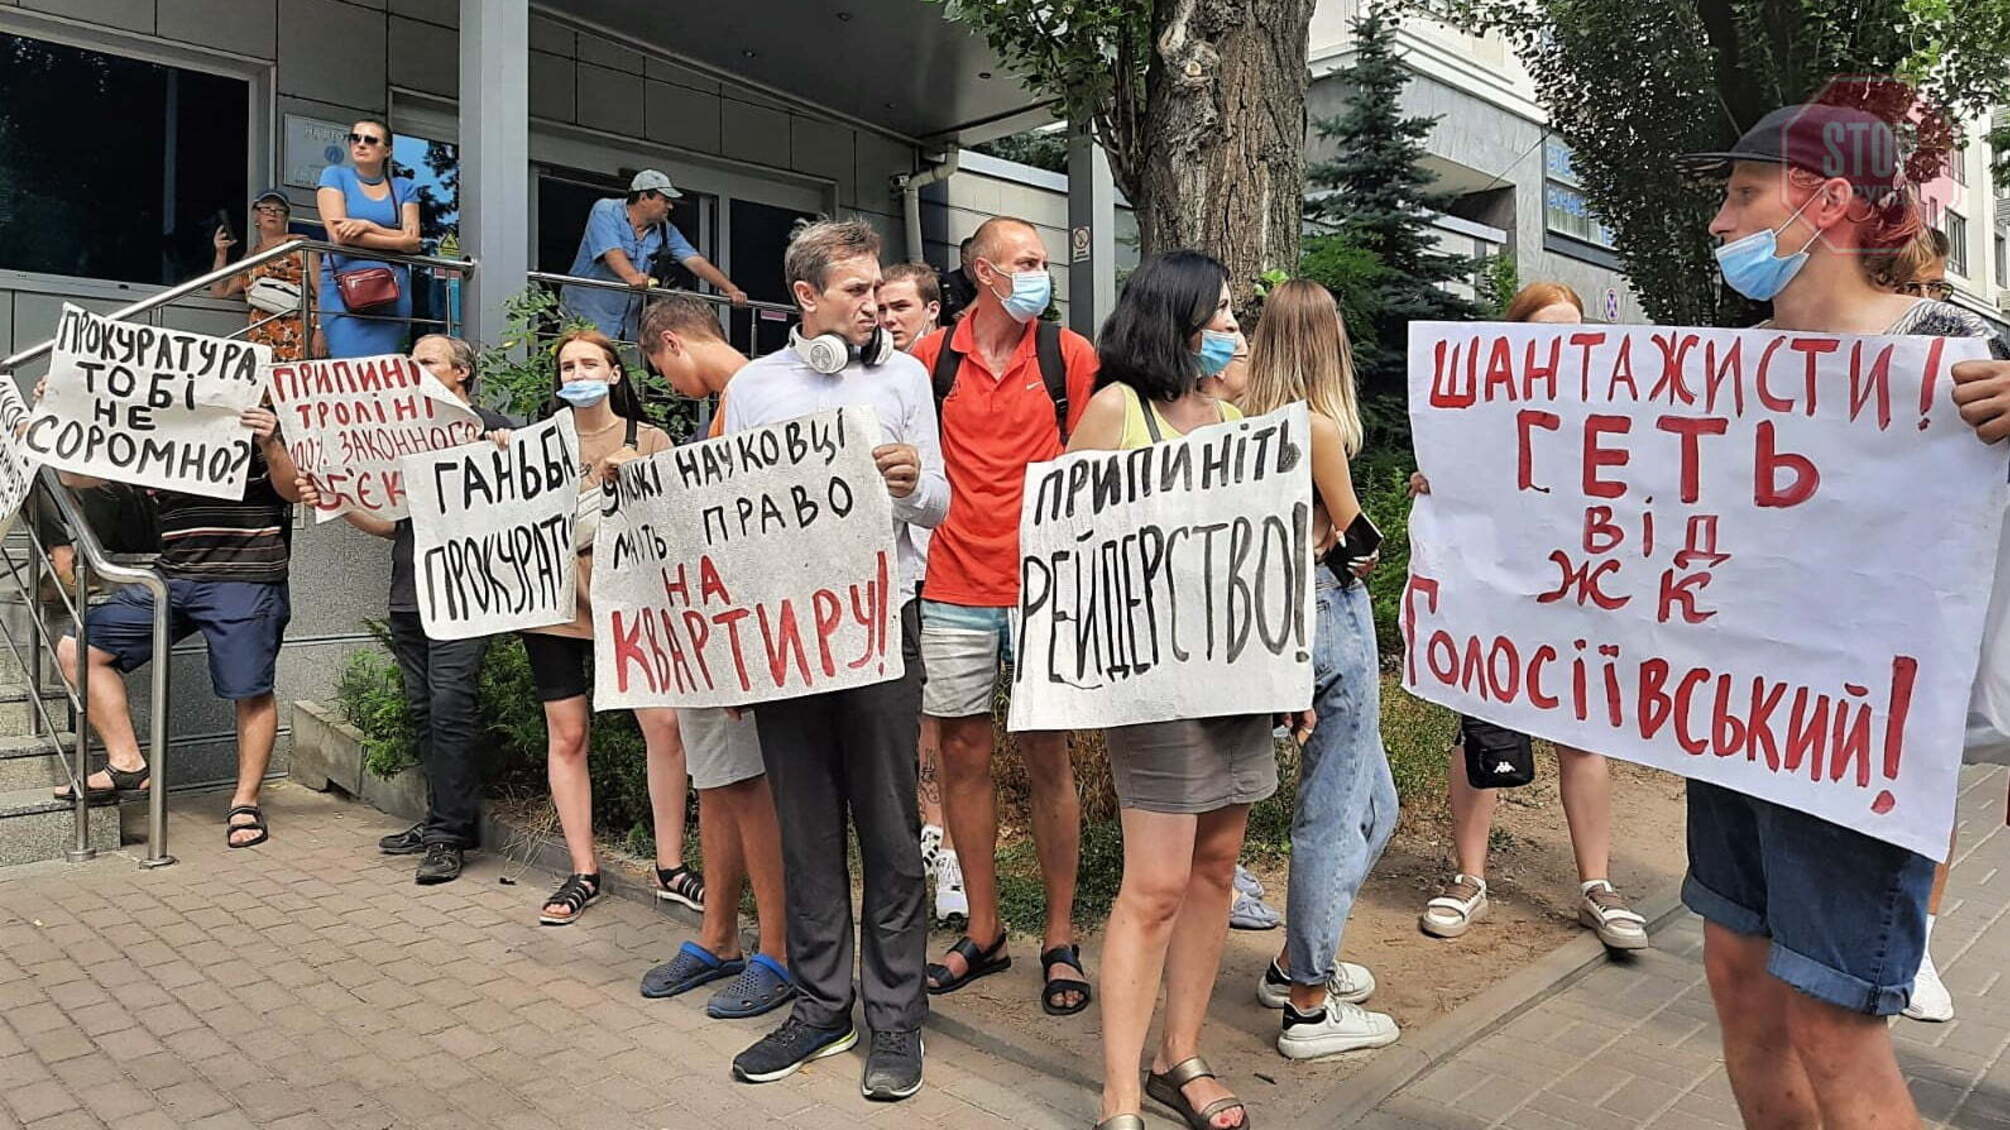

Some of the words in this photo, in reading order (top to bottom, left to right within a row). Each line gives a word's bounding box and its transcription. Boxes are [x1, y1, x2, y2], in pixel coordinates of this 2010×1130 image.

[58, 310, 258, 385] ПРОКУРАТУРА,
[76, 361, 196, 410] ТОБІ
[26, 415, 250, 485] СОРОМНО?
[94, 398, 156, 430] НЕ
[675, 407, 846, 490] НАУКОВЦІ
[434, 425, 576, 514] ГАНЬБА
[1034, 419, 1302, 526] ПРИПИНІТЬ
[1517, 409, 1821, 508] ГЕТЬ
[703, 476, 854, 545] ПРАВО
[661, 555, 731, 607] НА
[1016, 501, 1310, 689] РЕЙДЕРСТВО!
[611, 551, 889, 694] КВАРТИРУ!
